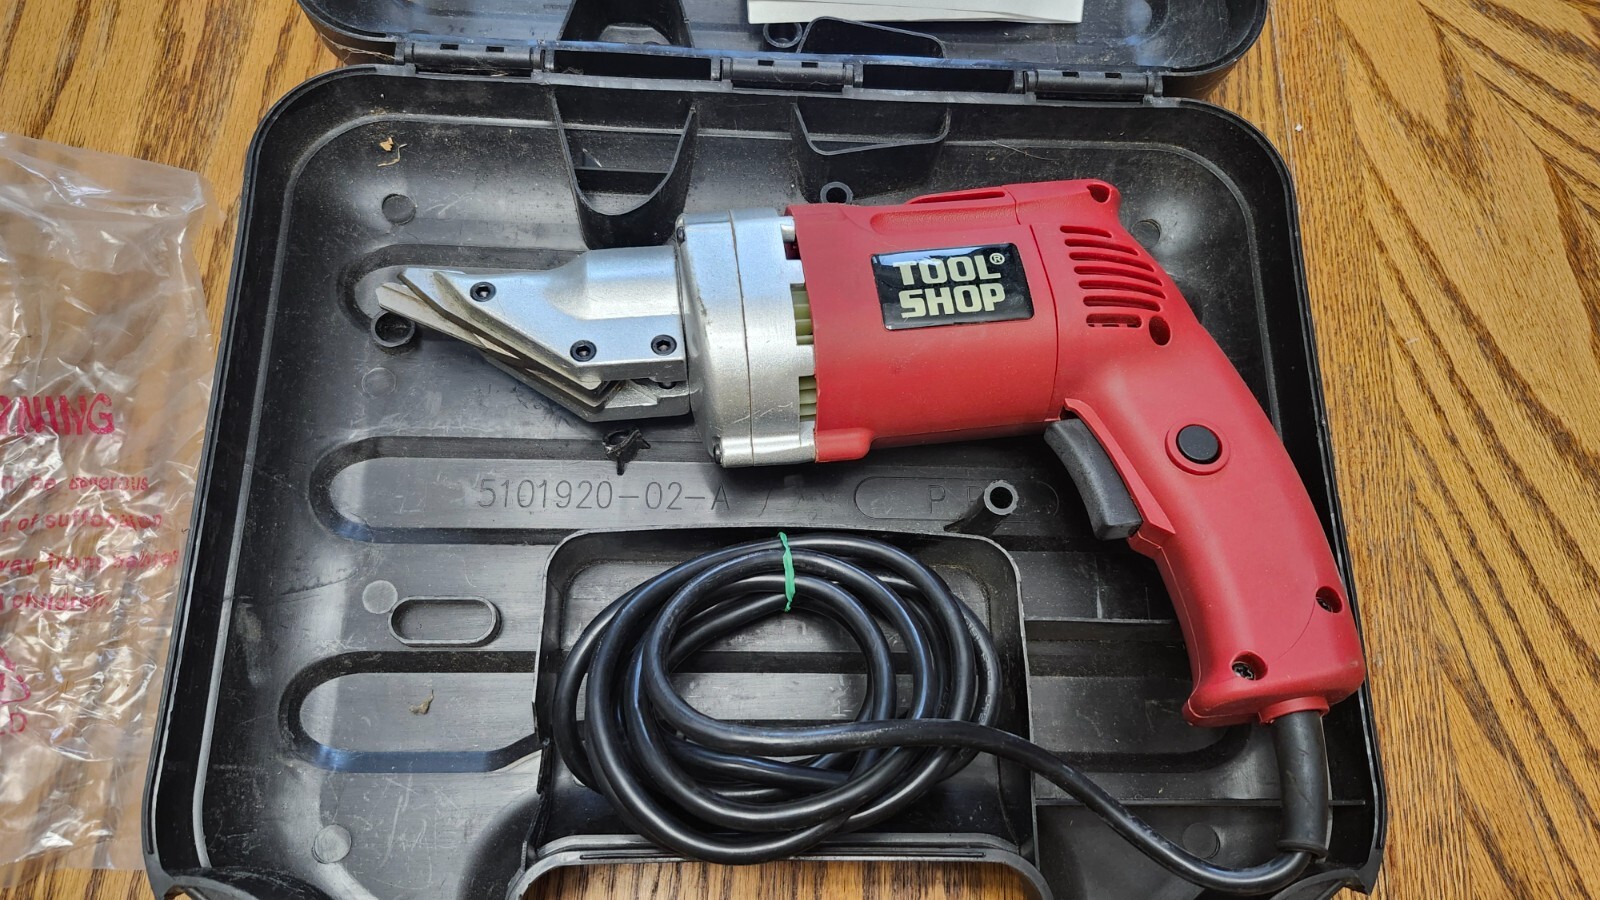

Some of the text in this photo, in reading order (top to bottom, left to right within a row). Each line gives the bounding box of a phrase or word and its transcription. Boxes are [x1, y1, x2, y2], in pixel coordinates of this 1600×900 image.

[898, 283, 1006, 319] SHOP
[69, 474, 149, 491] daerous
[477, 478, 731, 511] 5101920-02-A
[17, 513, 39, 531] of
